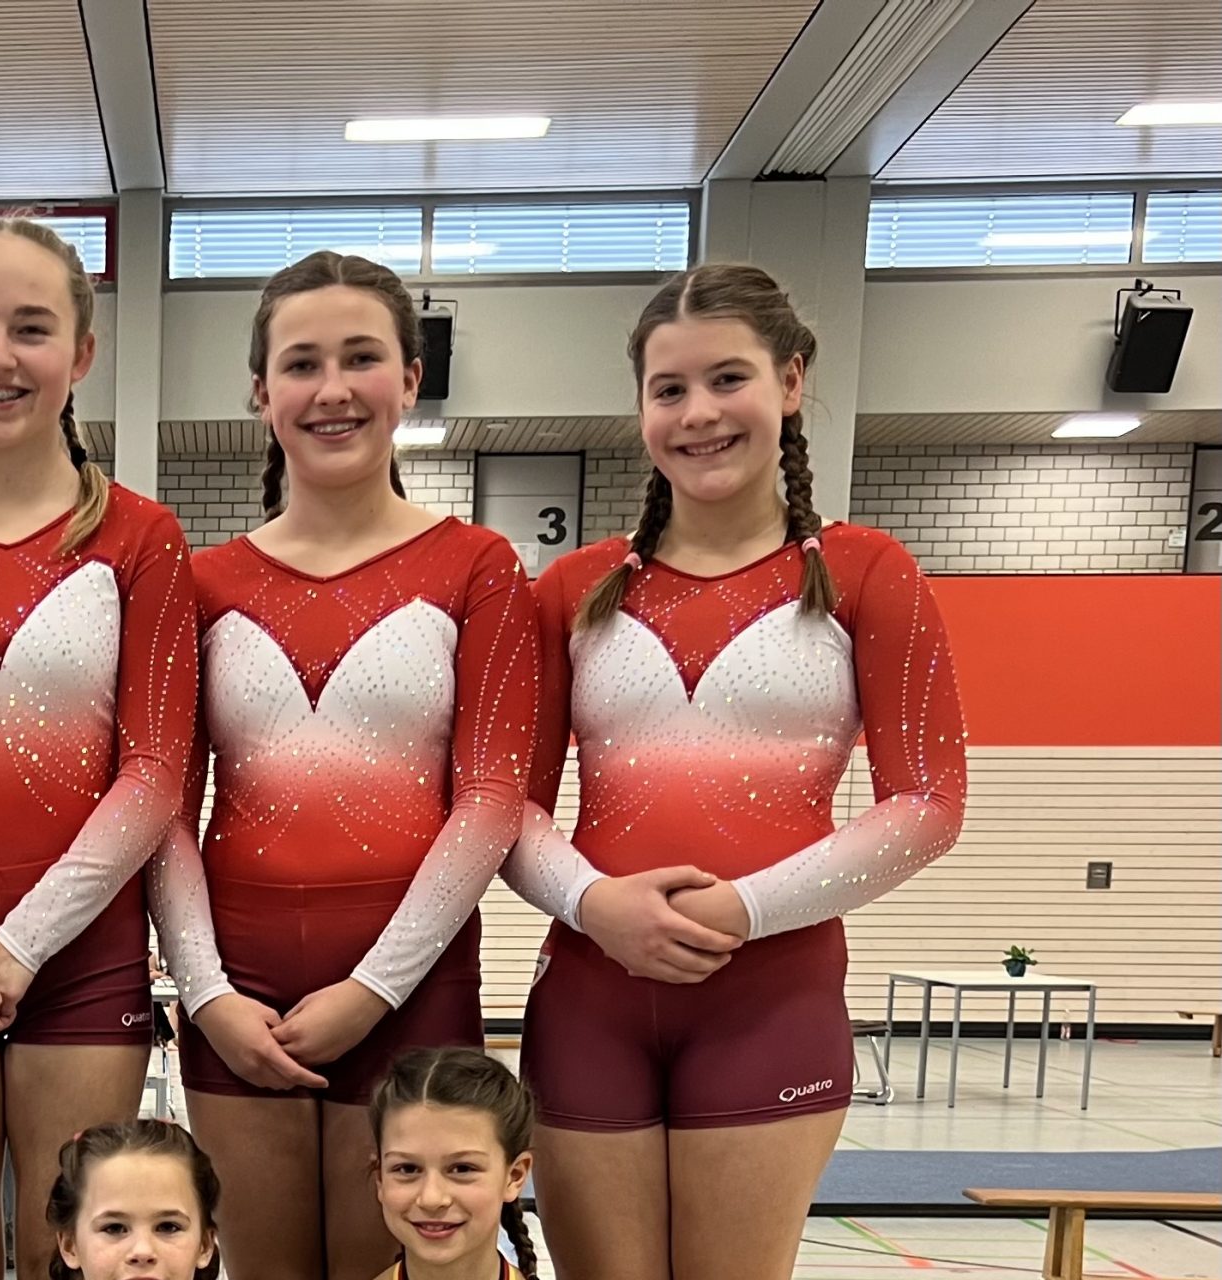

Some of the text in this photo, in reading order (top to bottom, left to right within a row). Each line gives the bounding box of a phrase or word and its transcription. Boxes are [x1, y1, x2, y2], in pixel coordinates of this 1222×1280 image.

[537, 506, 567, 545] 3
[1195, 501, 1222, 541] 2
[779, 1079, 833, 1102] Quatro
